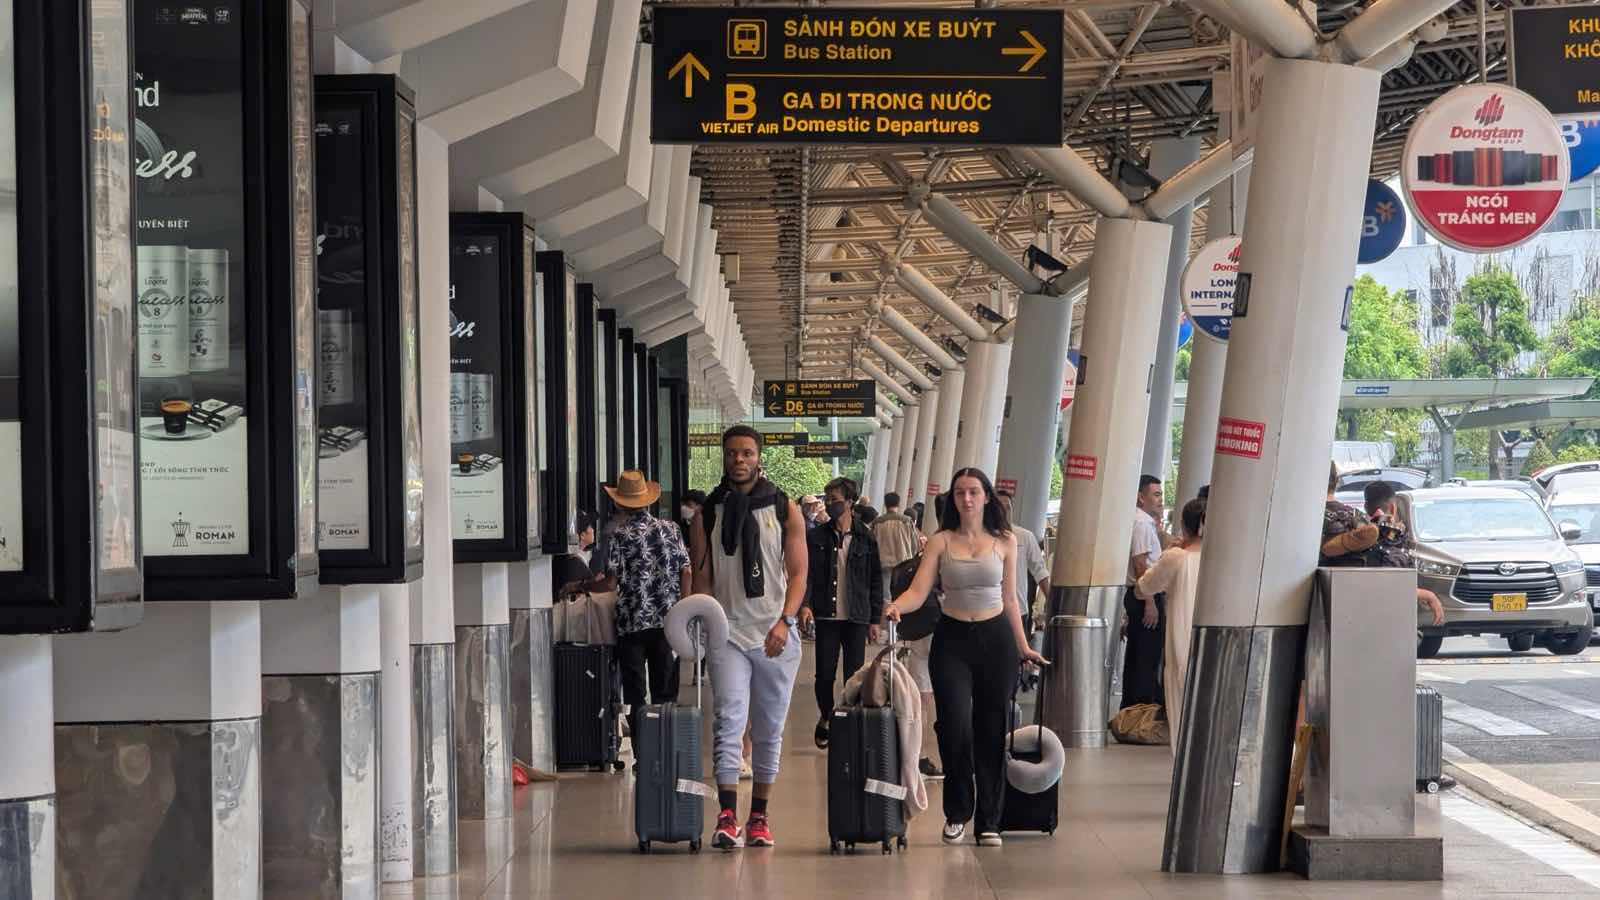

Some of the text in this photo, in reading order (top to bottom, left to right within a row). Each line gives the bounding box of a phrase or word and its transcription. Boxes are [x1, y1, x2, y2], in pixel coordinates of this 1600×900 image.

[784, 15, 996, 38] SẢNH ĐÓN XE BUÝT
[784, 45, 892, 60] Bus Station
[726, 84, 757, 121] B
[783, 88, 992, 110] GA ĐI TRONG NƯỚC
[701, 122, 779, 134] VIETJET AIR
[783, 116, 980, 137] Domestic Departures
[1450, 125, 1524, 141] Dongtam
[1466, 193, 1508, 208] NGÓI
[1438, 210, 1537, 226] TRÁNG MEN
[786, 400, 804, 412] D6
[196, 532, 236, 540] ROMAN
